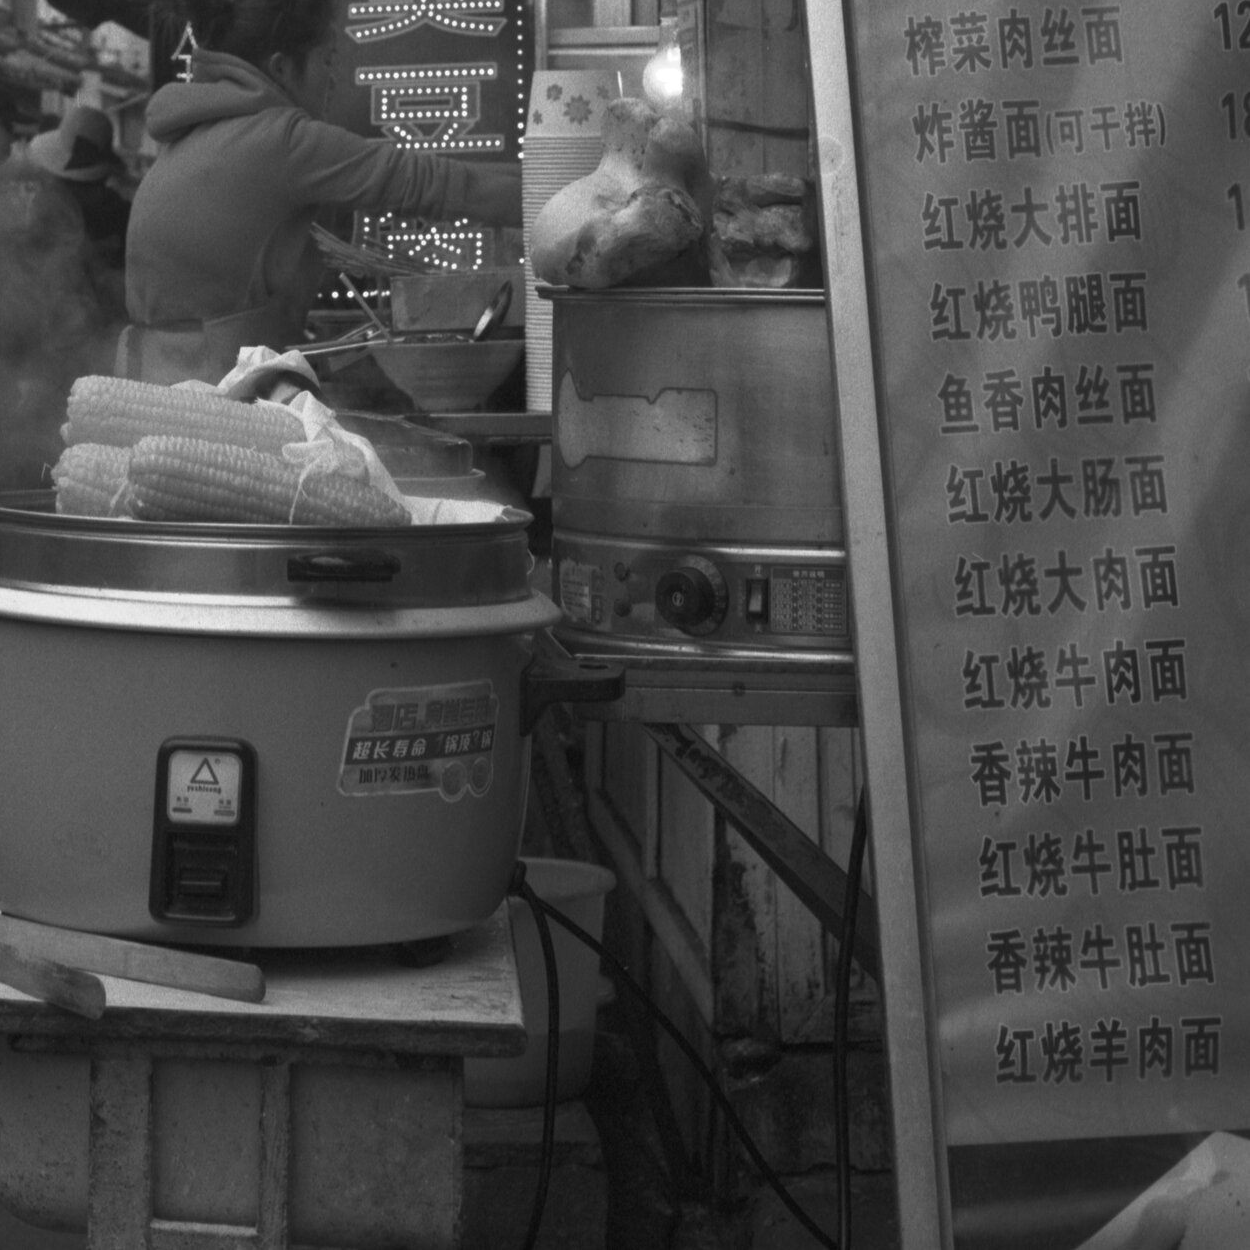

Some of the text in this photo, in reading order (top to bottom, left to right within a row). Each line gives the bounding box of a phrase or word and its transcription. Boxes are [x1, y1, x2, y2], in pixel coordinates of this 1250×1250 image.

[905, 6, 1123, 76] 榨菜肉丝面
[922, 181, 1141, 250] 红烧大排面
[930, 272, 1148, 341] 红烧鸭腿面
[938, 363, 1156, 434] 鱼香肉丝面
[946, 455, 1168, 524] 红烧大肠面
[954, 546, 1179, 617] 红烧大肉面
[962, 640, 1188, 709] 红烧牛肉面
[352, 738, 428, 760] 超长寿命
[970, 733, 1195, 806] 香辣牛肉面
[979, 827, 1203, 897] 红烧牛肚面
[987, 922, 1214, 994] 香辣牛肚面
[996, 1017, 1221, 1084] 红烧羊肉面
